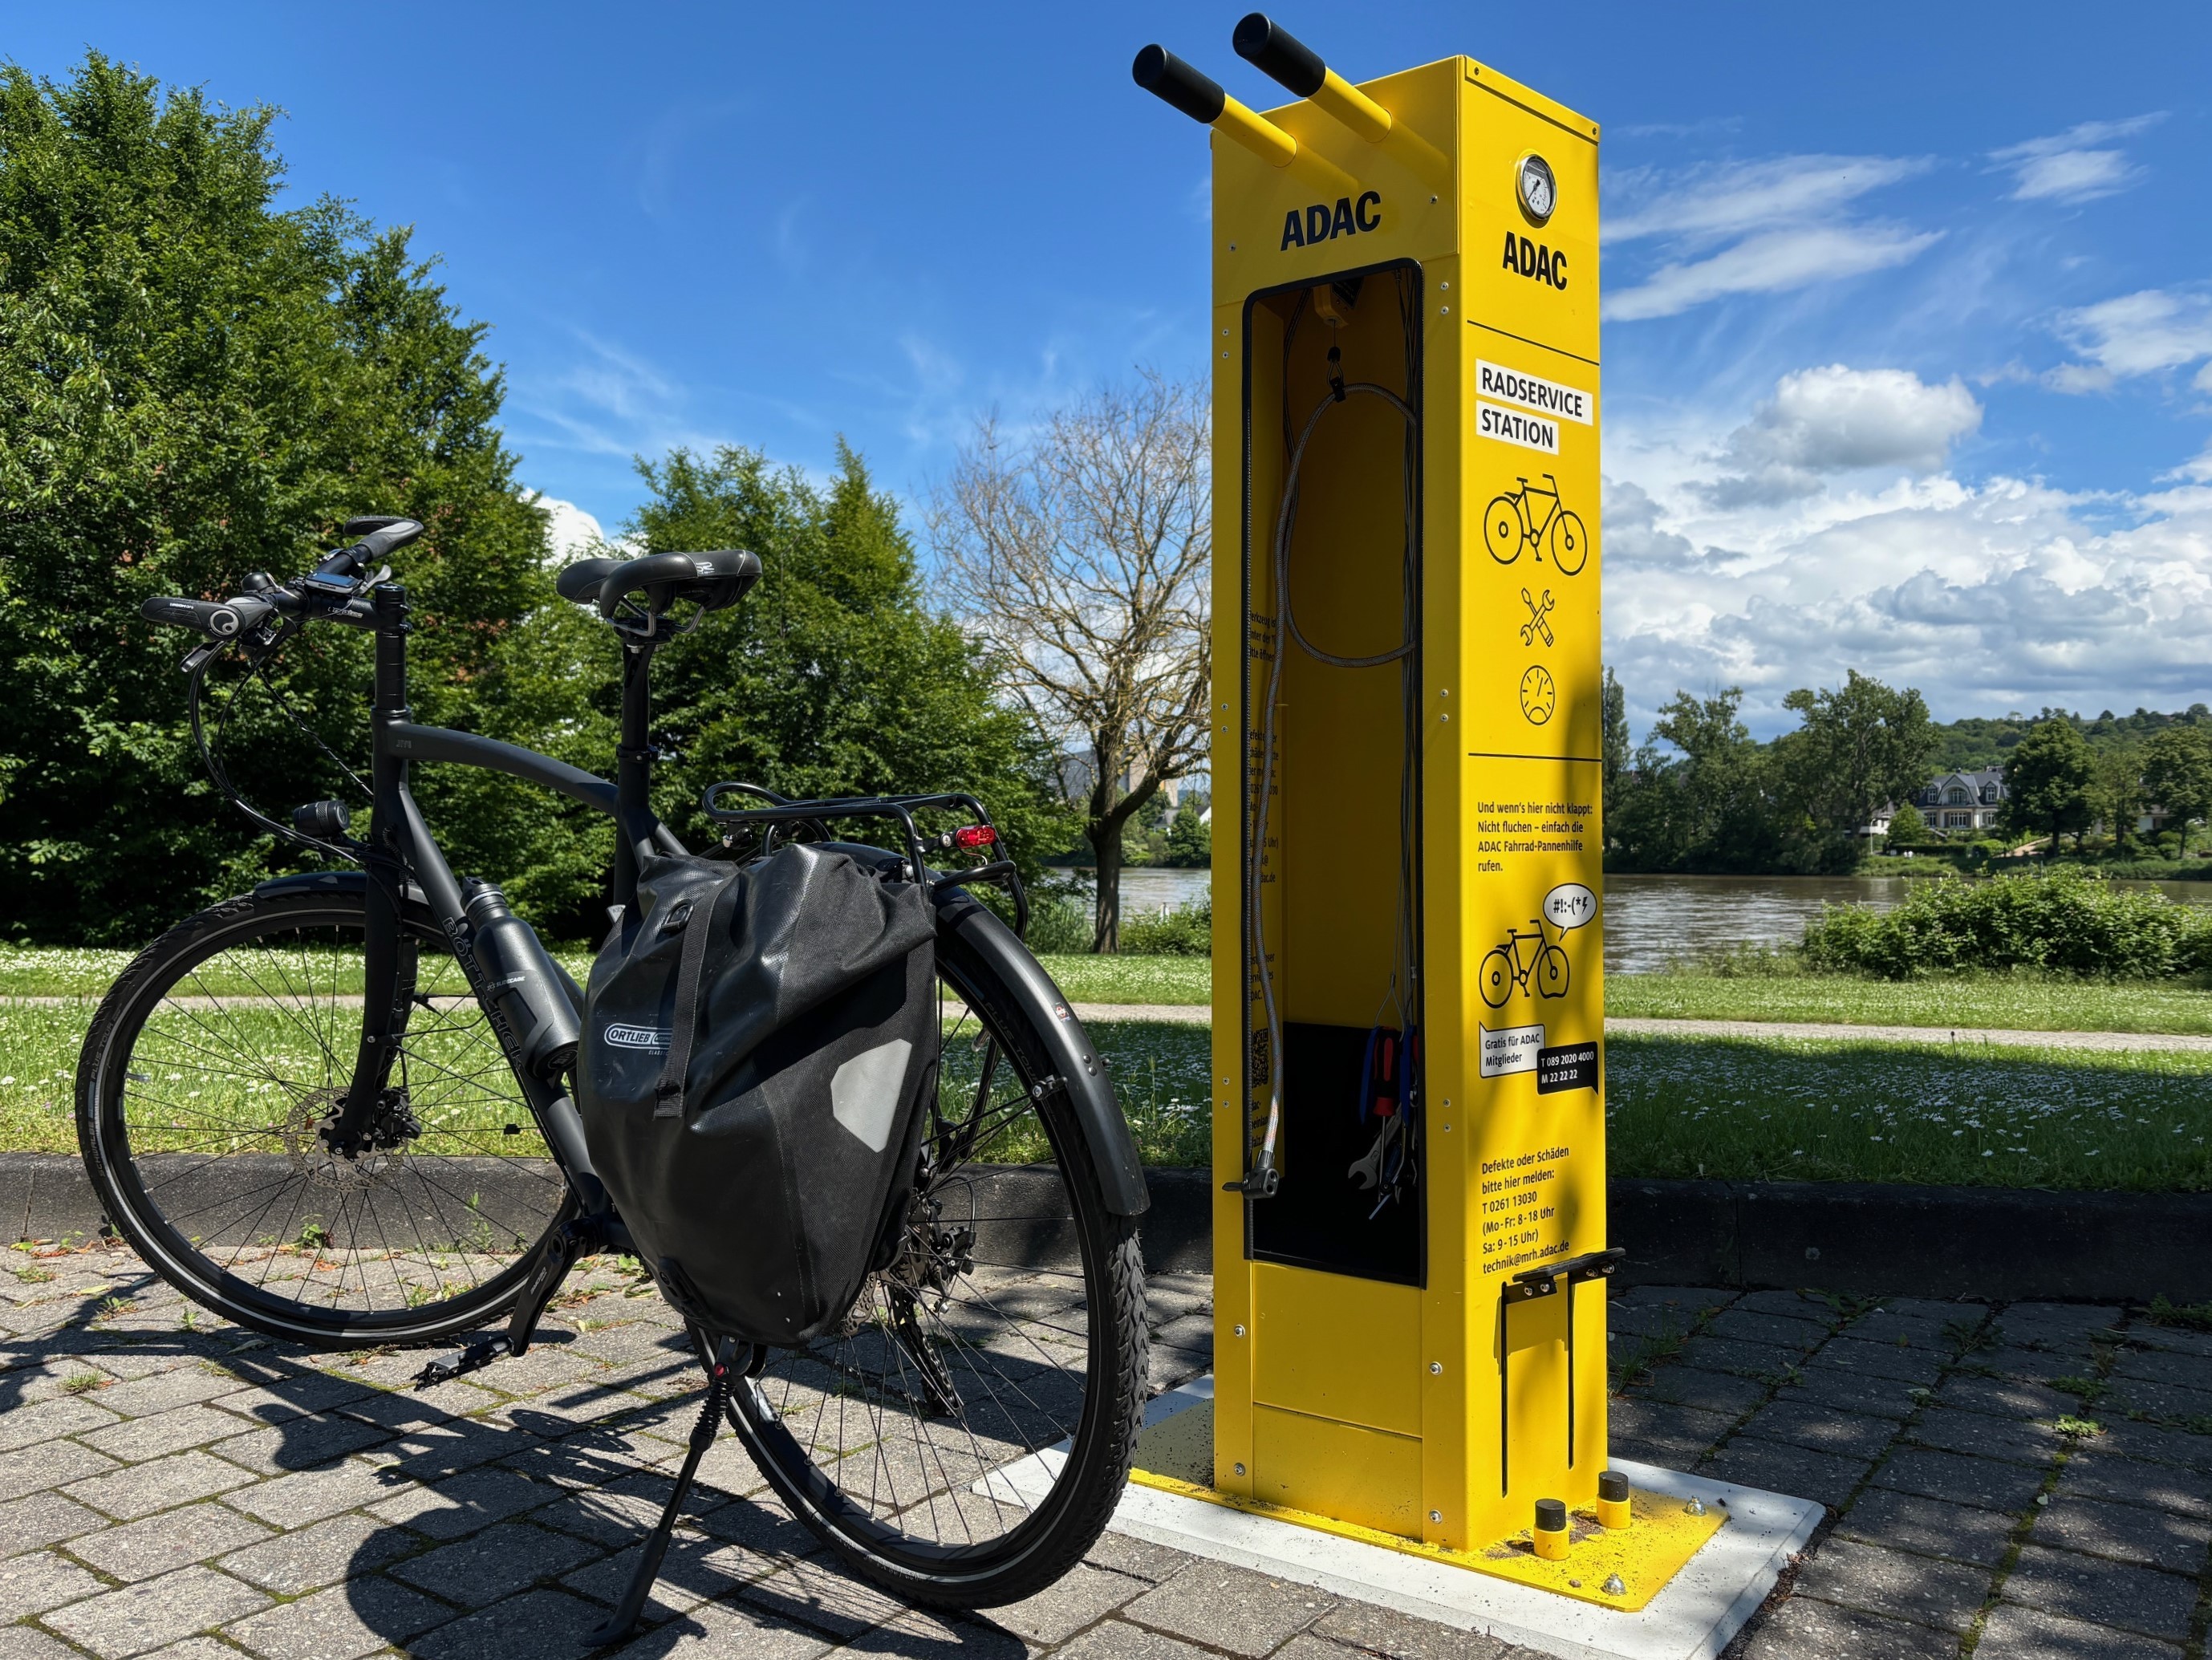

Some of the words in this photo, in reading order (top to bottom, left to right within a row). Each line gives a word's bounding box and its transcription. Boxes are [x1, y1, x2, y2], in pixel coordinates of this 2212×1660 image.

[1281, 191, 1382, 251] ADAC
[1502, 231, 1568, 290] ADAC
[1481, 367, 1583, 418] RADSERVICE
[1481, 409, 1554, 449] STATION
[1250, 612, 1270, 629] erkzeug
[1478, 802, 1494, 814] Und
[1528, 802, 1543, 814] hier
[1545, 802, 1565, 814] nicht
[1567, 802, 1593, 817] klappt:
[1478, 821, 1500, 833] Nicht
[1503, 821, 1532, 833] fluchen
[1541, 821, 1570, 833] einfach
[1571, 821, 1584, 833] die
[1478, 841, 1501, 852] ADAC
[1504, 839, 1583, 852] Fahrrad-Pannenhilfe
[1478, 859, 1503, 872] rufen.
[1251, 990, 1263, 1002] DAC.
[99, 1023, 113, 1049] TOUR
[611, 1029, 651, 1043] ORTLIEB
[984, 1001, 1015, 1041] PLUS
[1016, 1045, 1039, 1082] TOU
[1485, 1037, 1507, 1051] Gratis
[1508, 1036, 1519, 1047] für
[1520, 1033, 1540, 1045] ADAC
[91, 1049, 103, 1080] PLUS
[1485, 1053, 1522, 1068] Mitglieder
[1541, 1057, 1545, 1068] T
[1547, 1056, 1560, 1067] 089
[1561, 1053, 1577, 1065] 2020
[1578, 1051, 1594, 1063] 4000
[1541, 1074, 1548, 1084] M
[1549, 1072, 1558, 1083] 22
[1560, 1070, 1568, 1082] 22
[1569, 1069, 1578, 1080] 22
[88, 1120, 106, 1178] SCHWALBE
[1482, 1159, 1515, 1175] Defekte
[1516, 1154, 1535, 1167] oder
[1537, 1147, 1569, 1163] Schäden
[1482, 1178, 1502, 1195] bitte
[1504, 1175, 1520, 1190] hier
[1523, 1169, 1555, 1185] melden:
[1483, 1203, 1488, 1215] T
[1489, 1199, 1509, 1213] 0261
[1513, 1191, 1537, 1207] 13030
[1540, 1206, 1555, 1219] Uhr
[1483, 1242, 1496, 1255] Sa:
[1520, 1228, 1539, 1244] Uhr)
[1483, 1240, 1569, 1274] technik@mrh.adac.de
